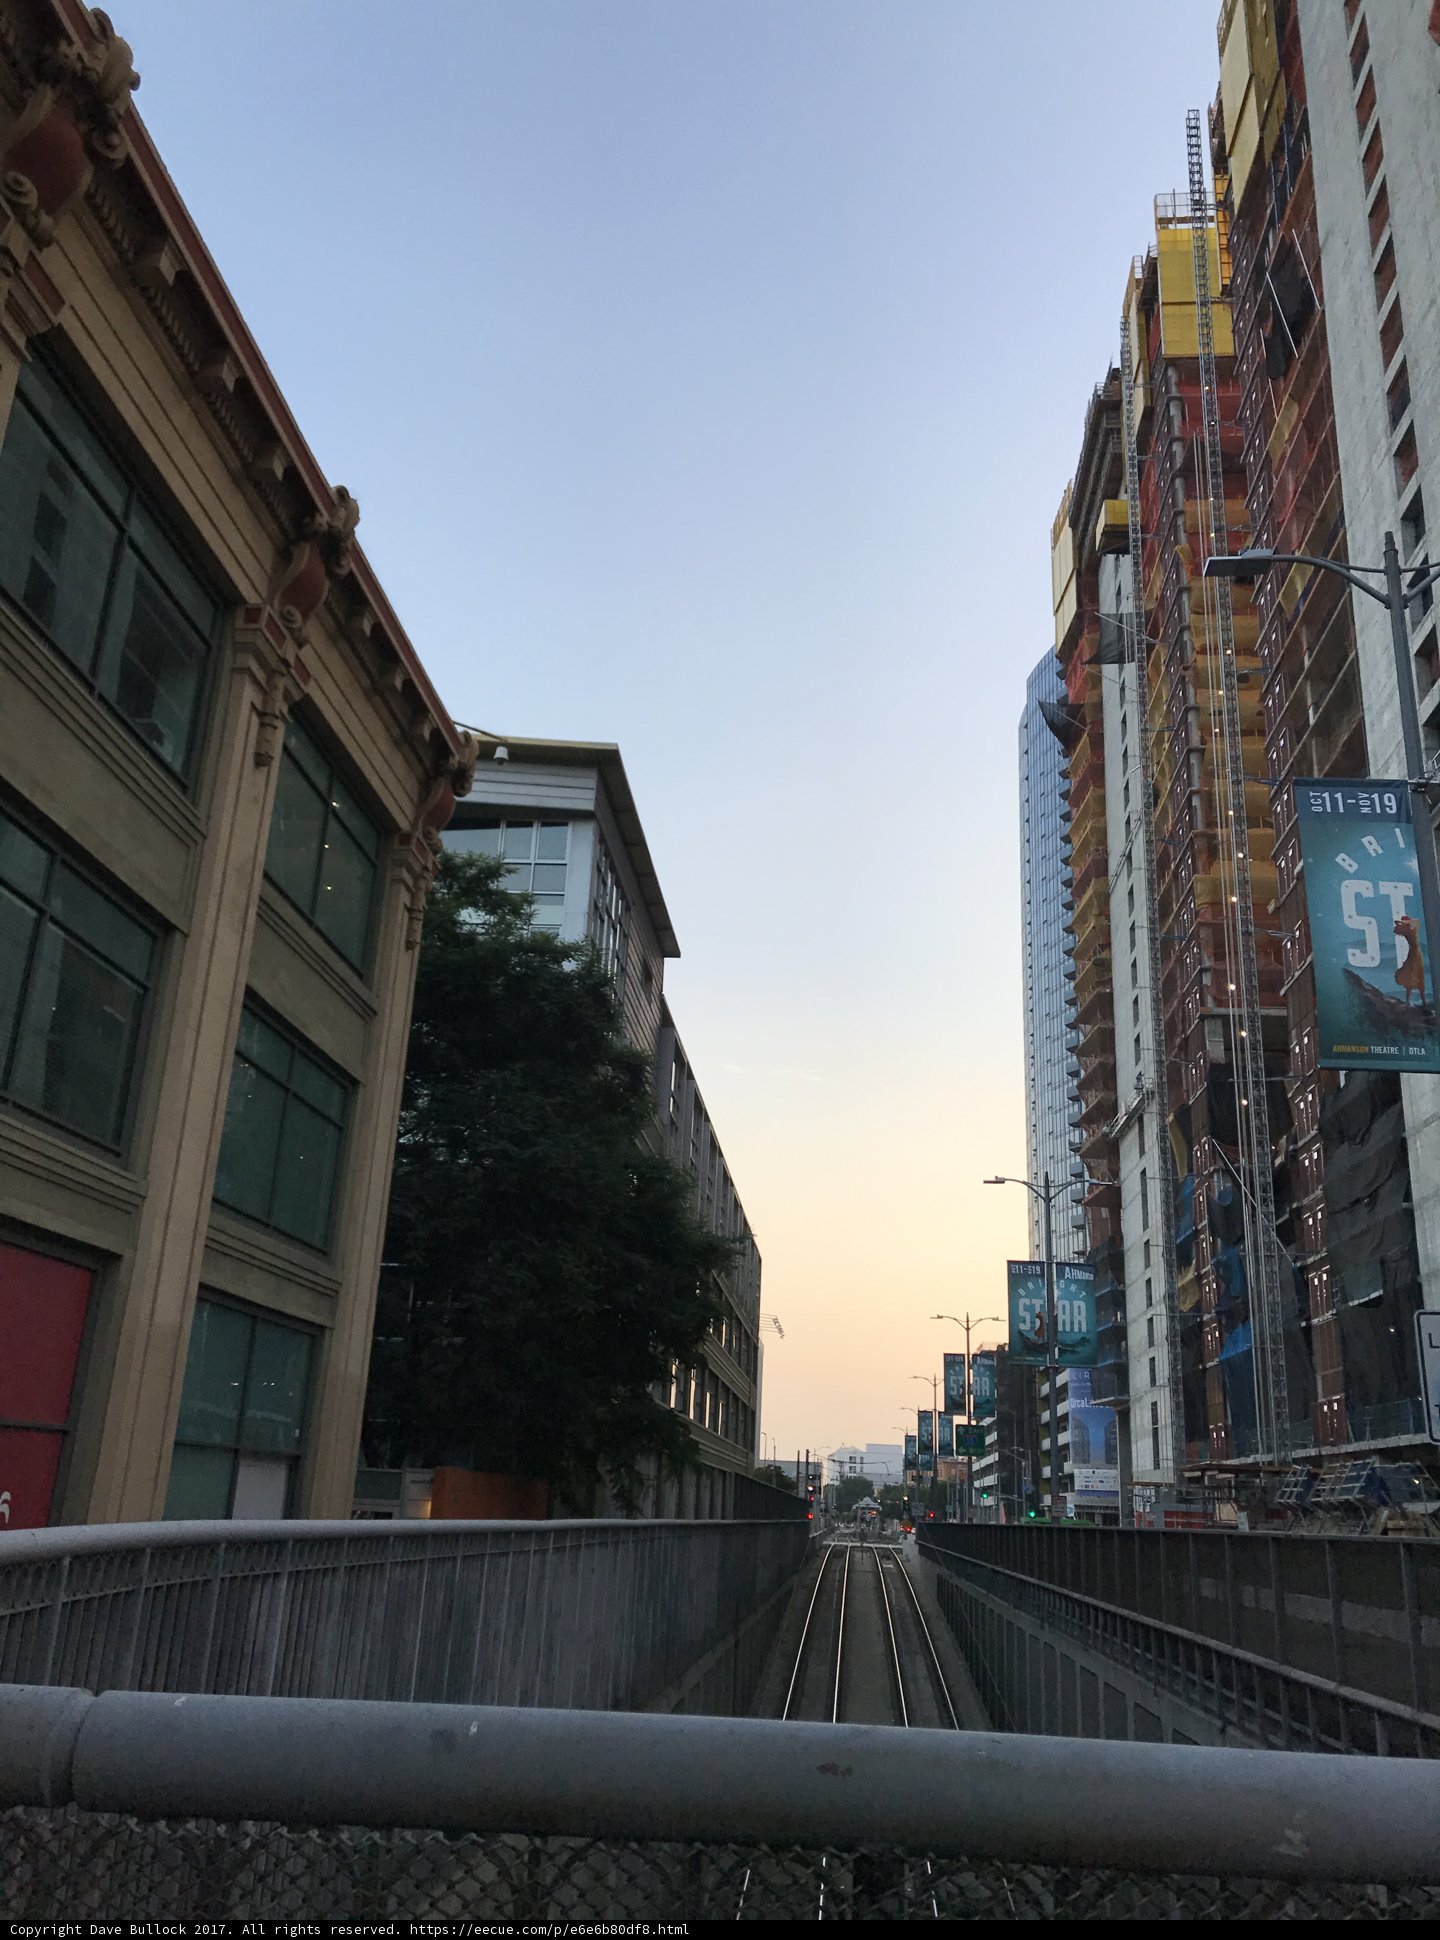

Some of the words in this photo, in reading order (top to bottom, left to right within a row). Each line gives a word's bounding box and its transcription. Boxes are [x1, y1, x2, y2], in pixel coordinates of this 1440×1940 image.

[1309, 791, 1323, 812] OCT
[1358, 792, 1372, 813] NOV
[1371, 792, 1397, 814] 19
[1370, 1046, 1399, 1055] THEATRE
[1408, 1047, 1426, 1056] DTLA
